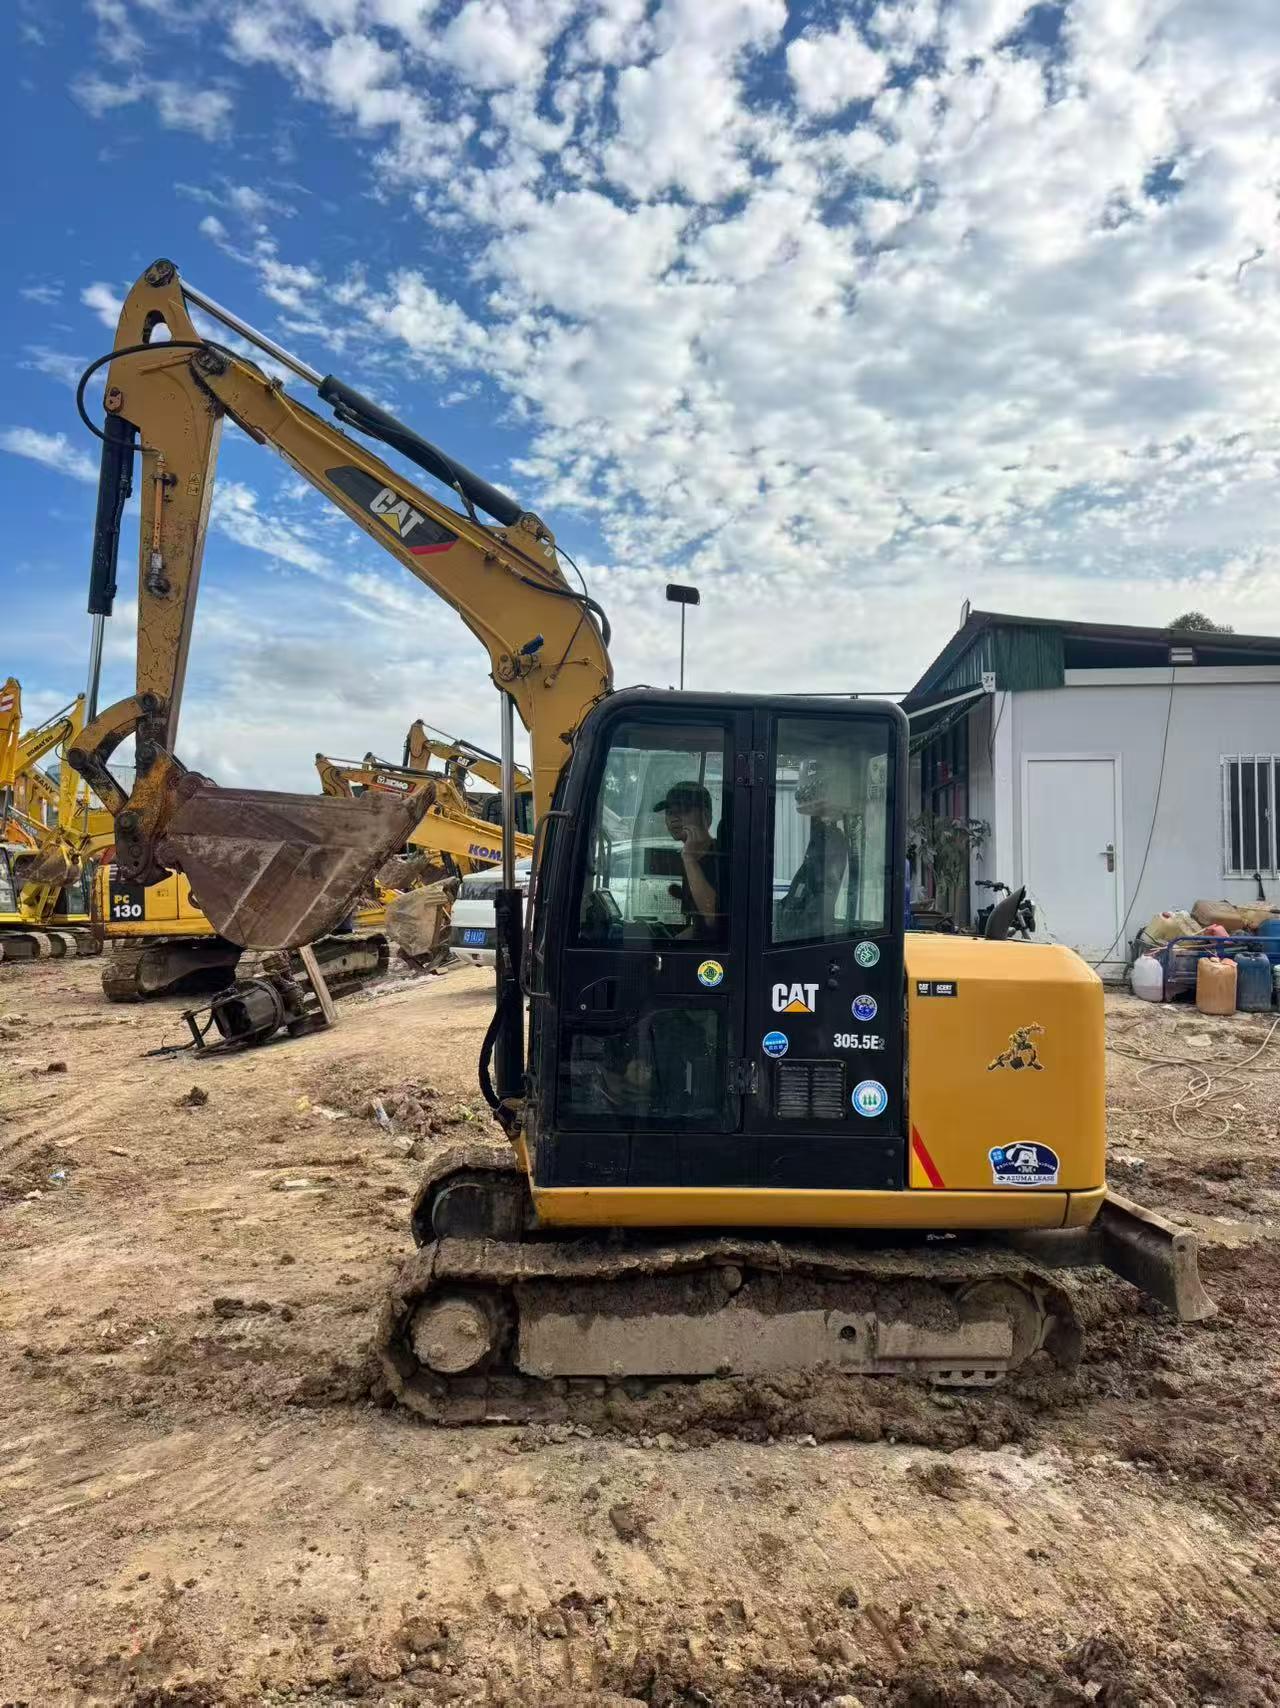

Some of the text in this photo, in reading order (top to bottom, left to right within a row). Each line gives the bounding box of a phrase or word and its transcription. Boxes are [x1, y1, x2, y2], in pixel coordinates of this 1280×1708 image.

[370, 488, 425, 538] CAT
[32, 773, 56, 794] SANY
[113, 894, 130, 904] PC
[113, 904, 142, 918] 130
[771, 983, 820, 1013] CAT
